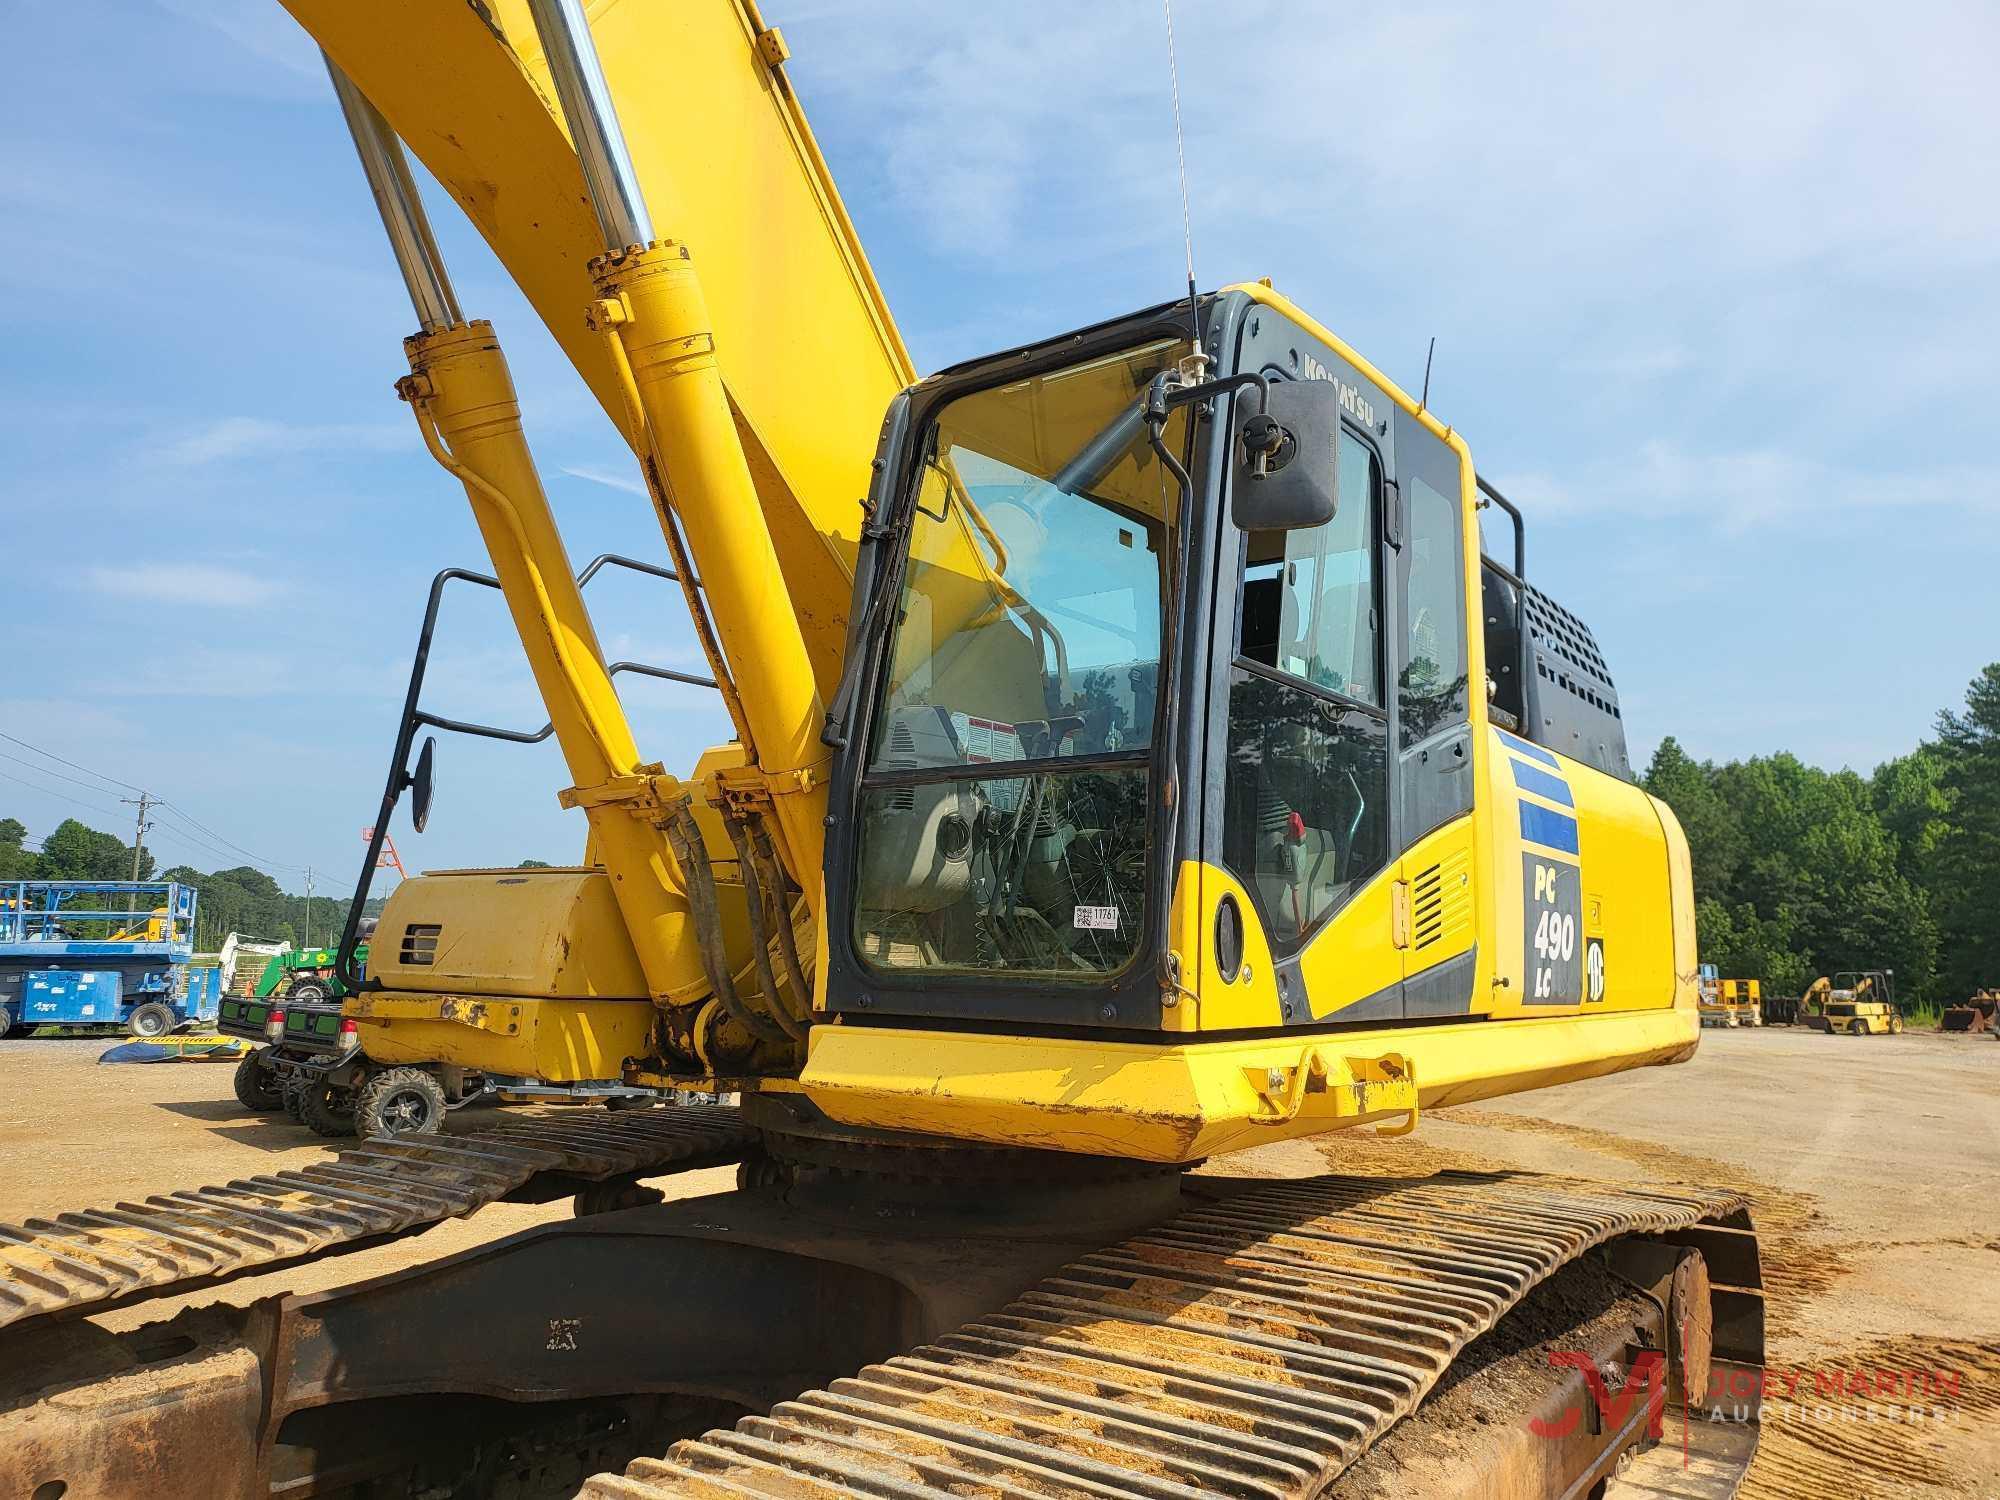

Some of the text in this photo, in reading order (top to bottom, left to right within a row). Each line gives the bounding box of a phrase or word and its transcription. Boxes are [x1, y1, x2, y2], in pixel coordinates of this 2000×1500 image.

[1534, 864, 1557, 904] PC
[1094, 908, 1116, 920] 17761
[1534, 910, 1575, 962] 490
[1534, 967, 1552, 998] LC
